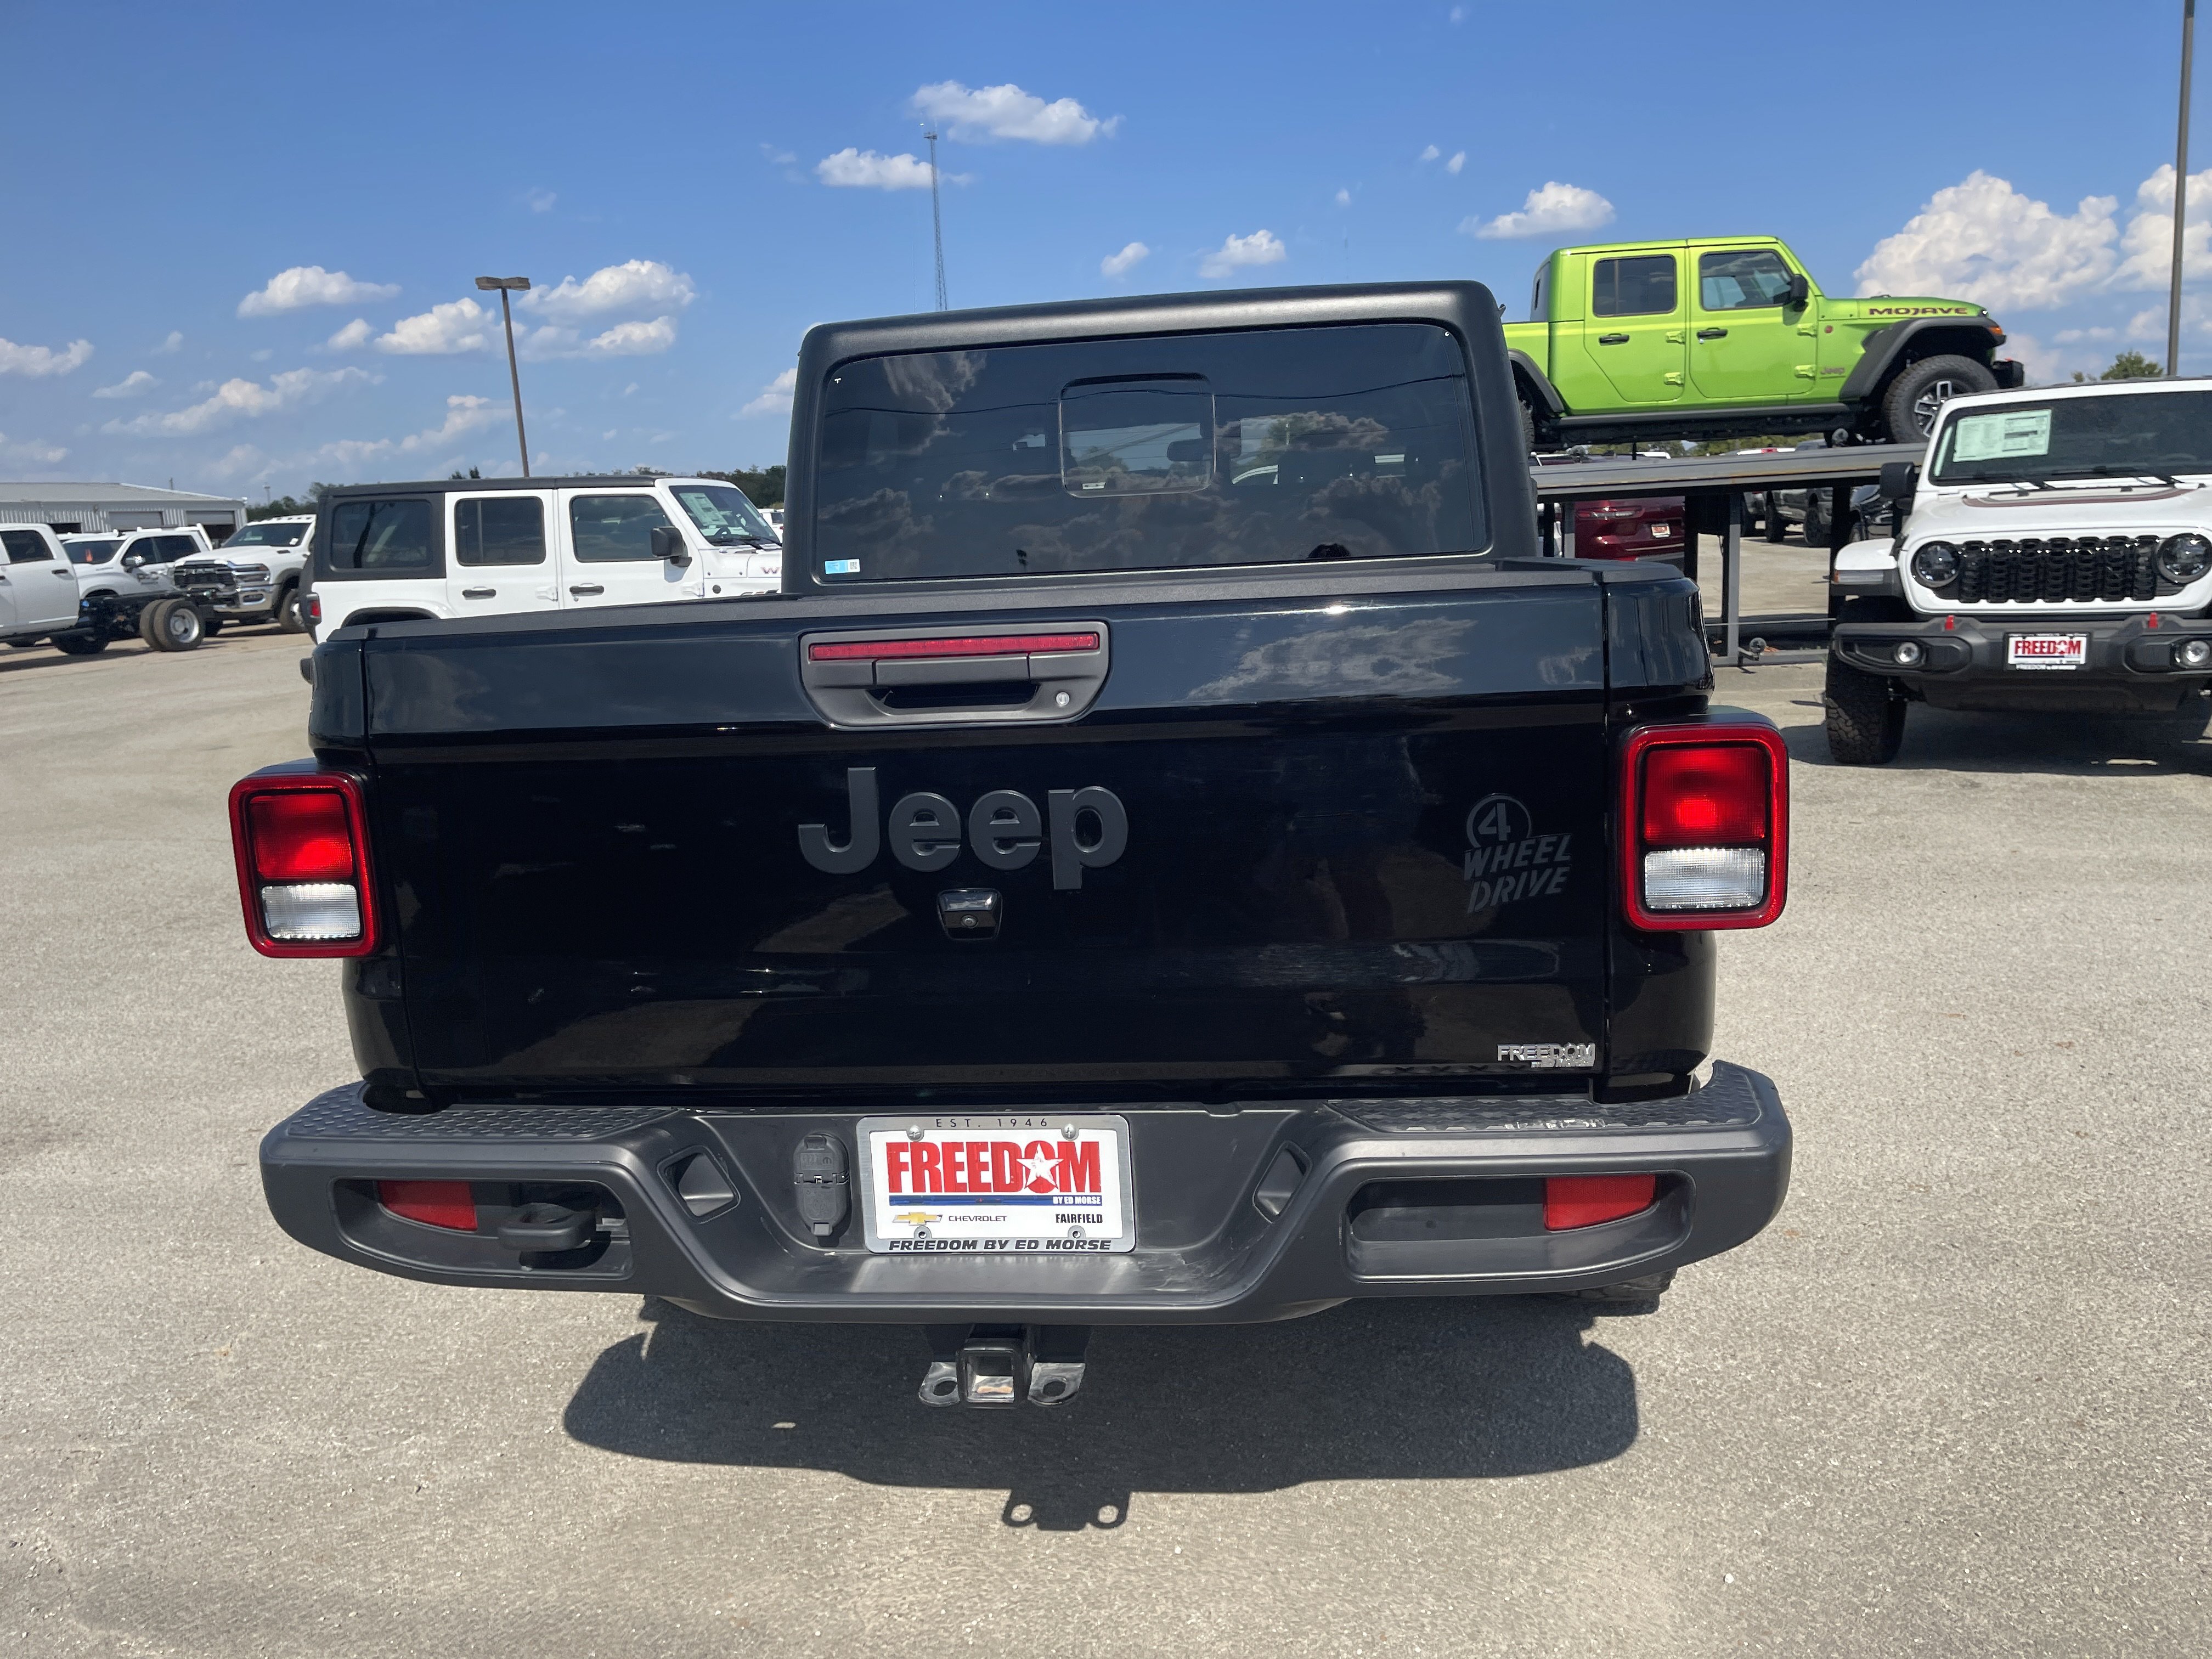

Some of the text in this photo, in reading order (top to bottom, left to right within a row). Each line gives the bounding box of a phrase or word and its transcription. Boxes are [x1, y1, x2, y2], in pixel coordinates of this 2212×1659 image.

[1869, 307, 1968, 315] MOJAVE
[2015, 640, 2081, 654] FREEDOM
[798, 766, 1129, 890] Jeep
[1477, 803, 1511, 842] 4
[1463, 833, 1572, 881] WHEEL
[1466, 866, 1571, 913] DRIVE
[1497, 1042, 1596, 1061] FREEDOM
[935, 1118, 1047, 1127] EST. 1946
[885, 1140, 1102, 1194] FREEDOM
[1053, 1196, 1101, 1204] BY ED MORSE
[1055, 1214, 1103, 1223] FAIRFIELD
[888, 1239, 1112, 1251] FREEDOM BY ED MORSE
